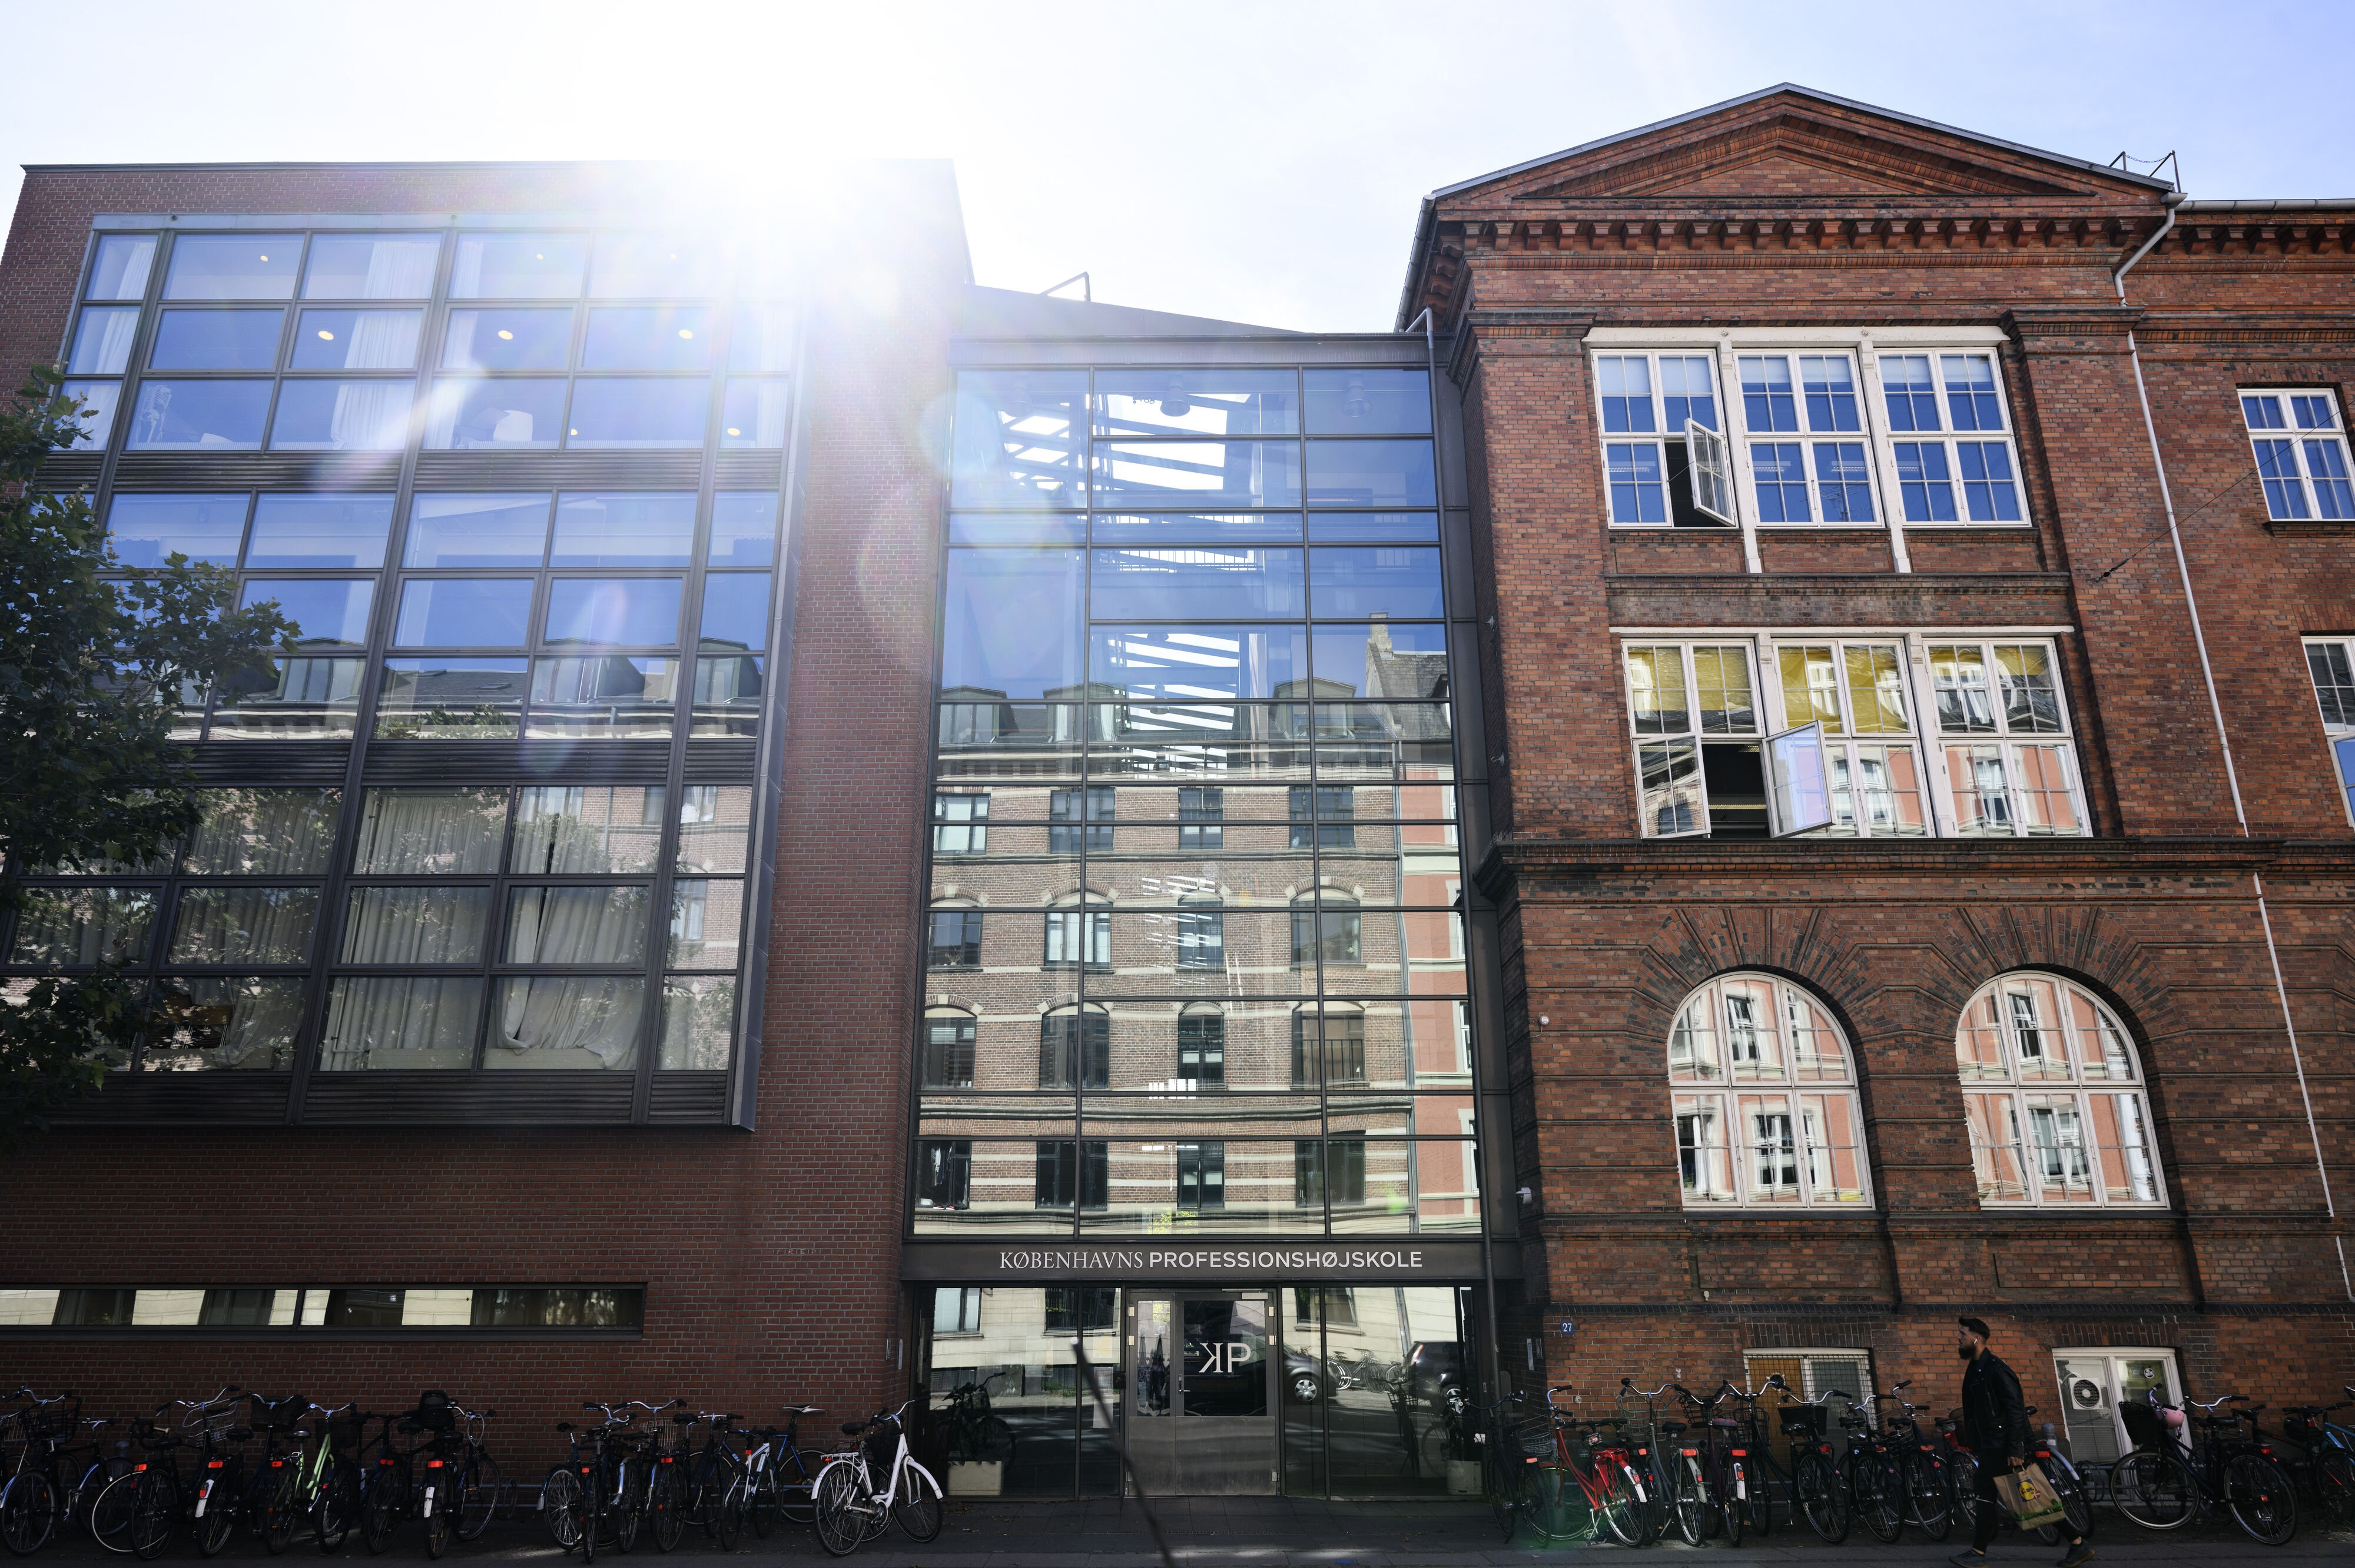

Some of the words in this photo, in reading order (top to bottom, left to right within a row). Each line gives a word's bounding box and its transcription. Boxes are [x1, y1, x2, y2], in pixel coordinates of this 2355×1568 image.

[1000, 1251, 1143, 1269] KØBENHAVNS
[1150, 1251, 1422, 1268] PROFESSIONSHØJSKOLE
[1562, 1323, 1573, 1333] 27
